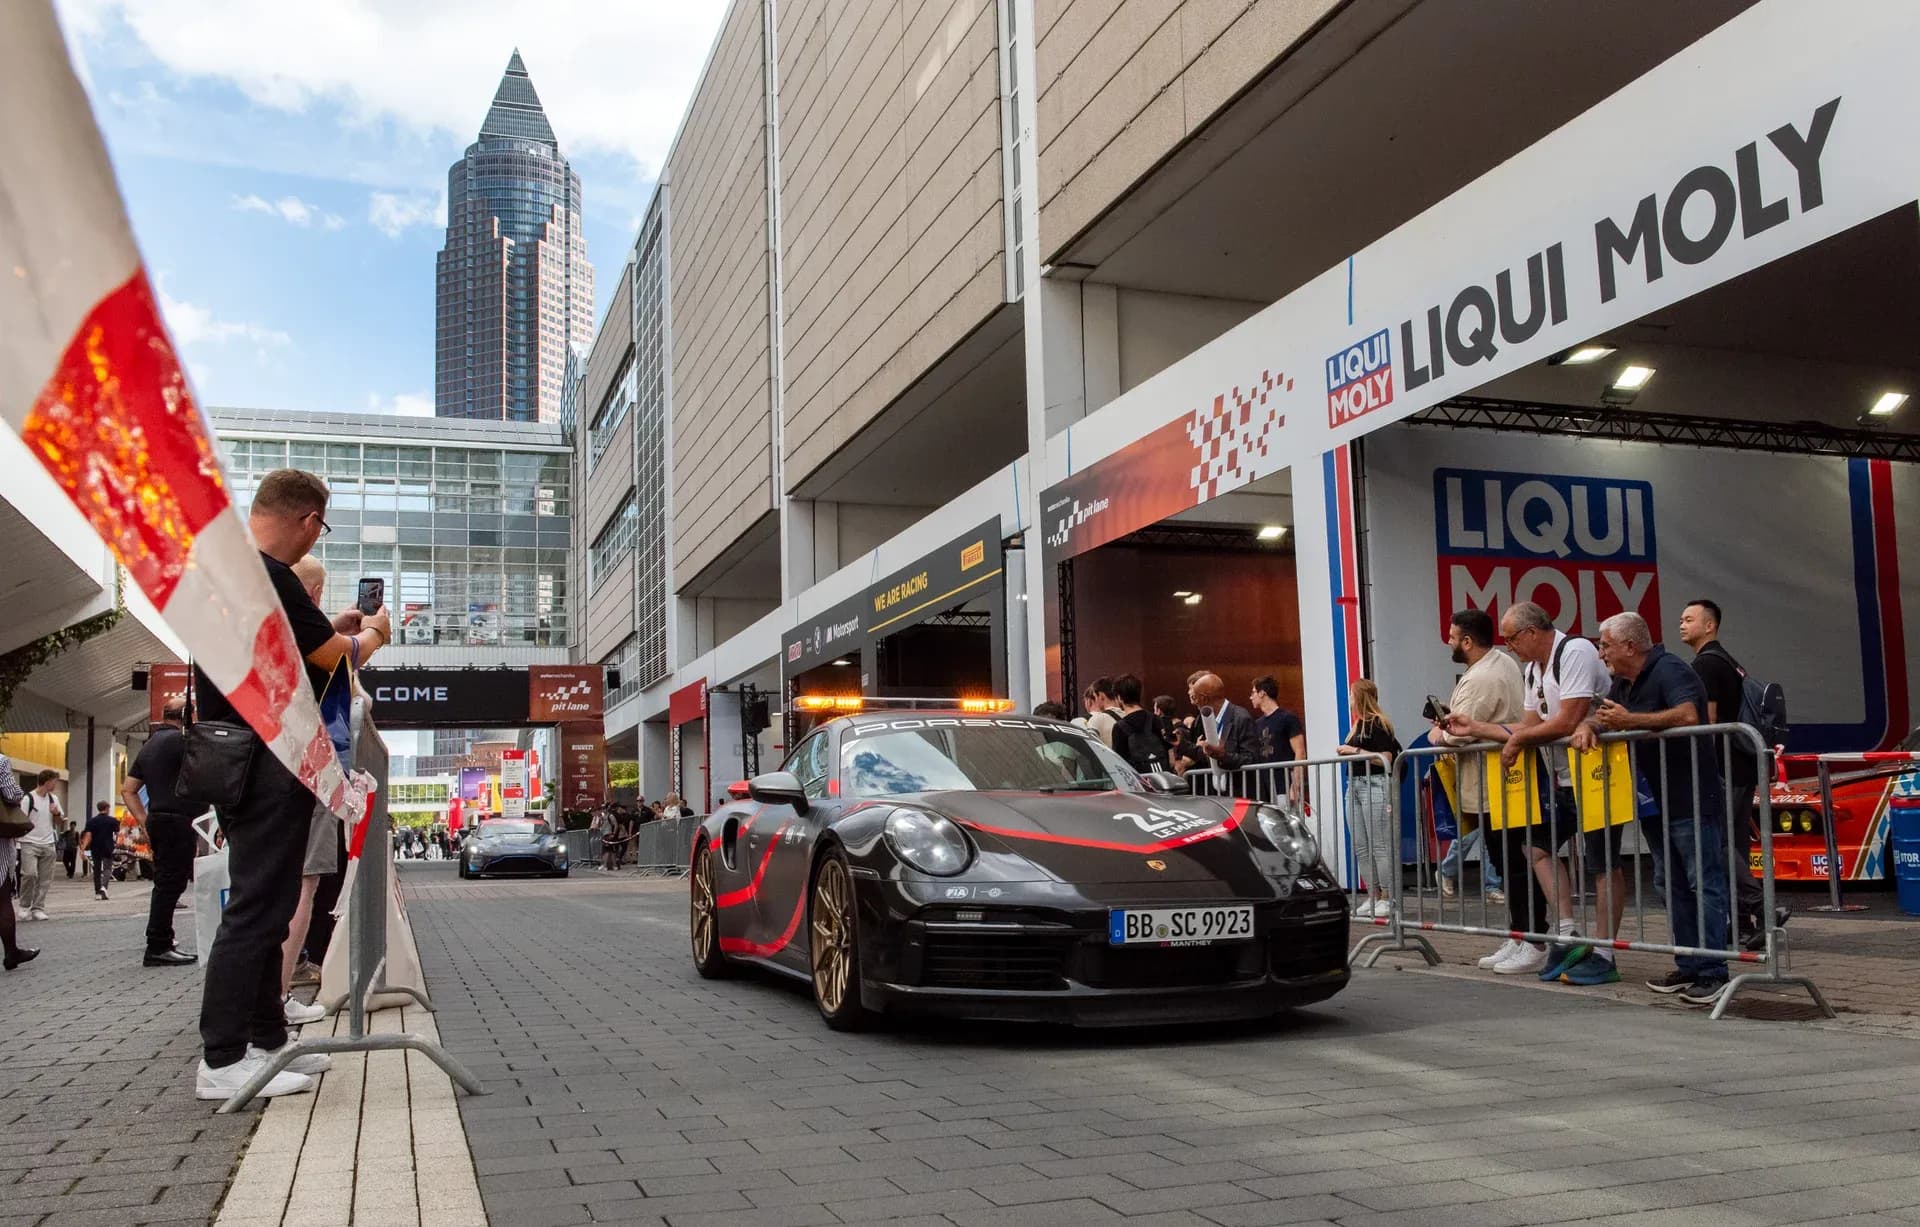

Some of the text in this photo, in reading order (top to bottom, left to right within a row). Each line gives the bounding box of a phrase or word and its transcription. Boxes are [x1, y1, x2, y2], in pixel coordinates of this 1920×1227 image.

[1400, 95, 1843, 393] LIQUI MOLY
[1328, 332, 1389, 390] LIQUI
[1331, 368, 1391, 425] MOLY
[1083, 502, 1093, 522] pit
[1094, 498, 1109, 513] lane
[1446, 477, 1647, 558] LIQUI
[874, 571, 929, 613] WE ARE RACING
[1451, 564, 1656, 639] MOLY
[833, 616, 859, 640] Motorsport
[372, 686, 449, 701] COME
[551, 701, 590, 712] pit lane
[854, 719, 1090, 739] PORSCHE
[1113, 808, 1200, 832] 24h
[1152, 826, 1177, 839] LE
[1176, 817, 1217, 833] MANS
[945, 887, 968, 898] FIA
[1126, 913, 1153, 938] BB
[1171, 912, 1197, 937] SC
[1202, 909, 1251, 936] 9923
[1170, 939, 1212, 948] MANTHEY
